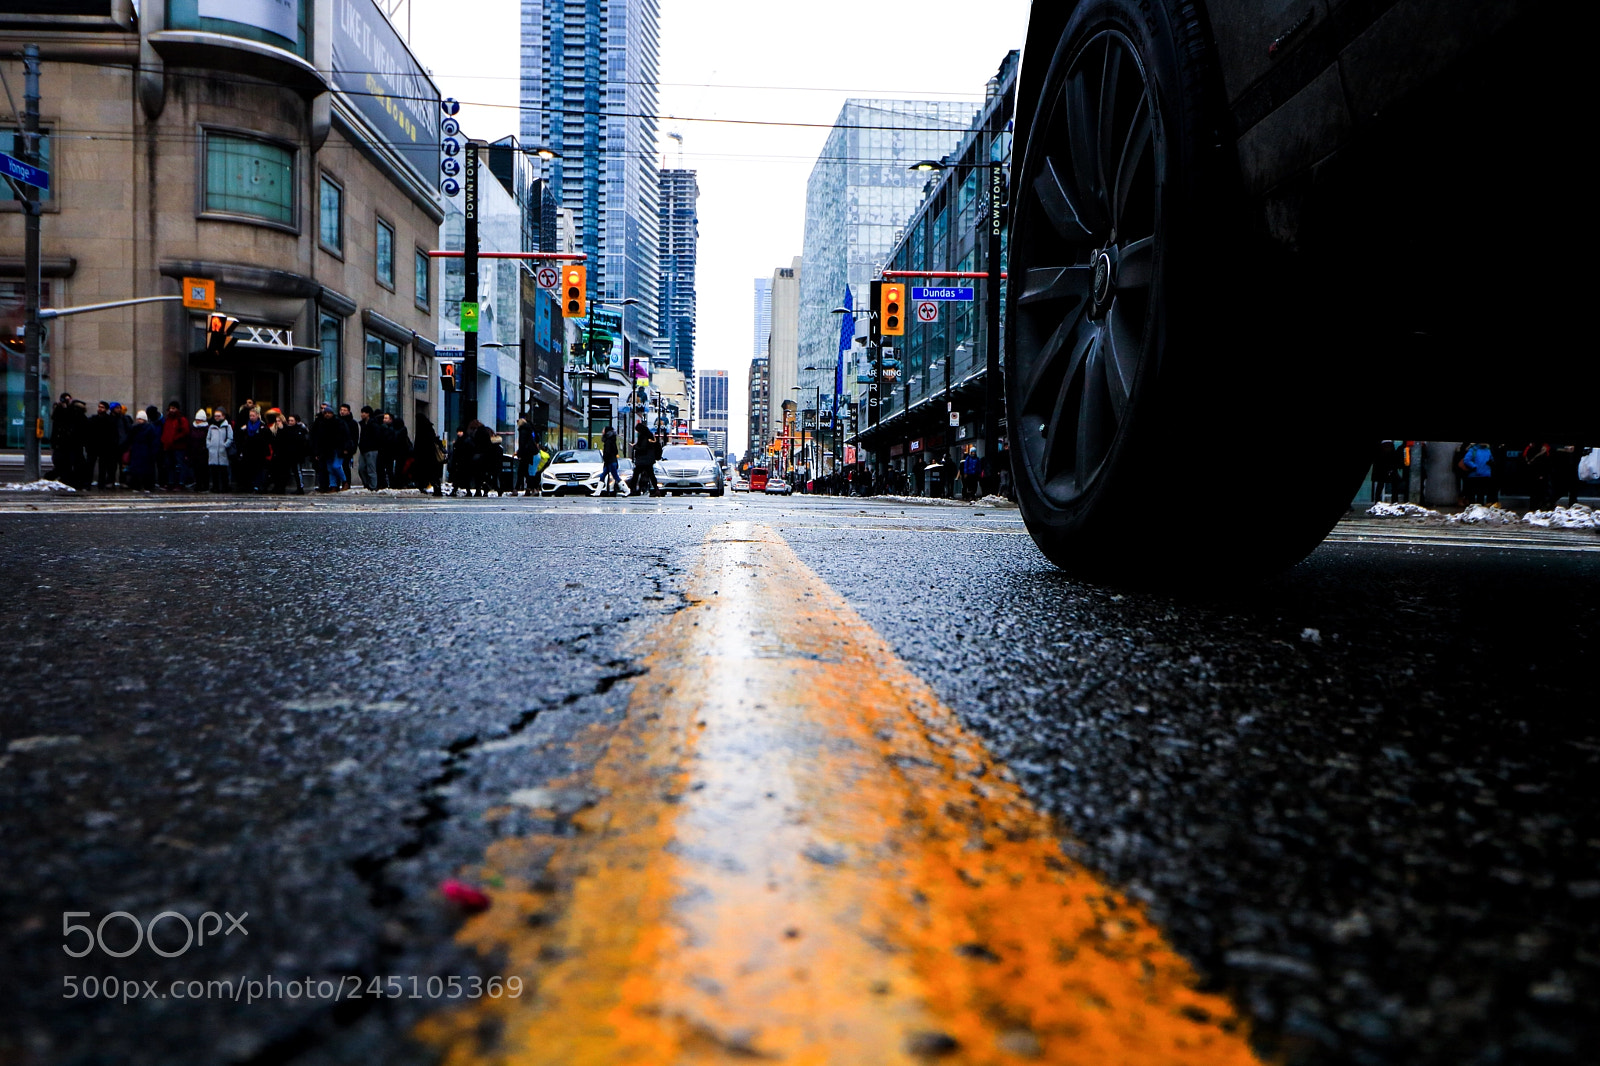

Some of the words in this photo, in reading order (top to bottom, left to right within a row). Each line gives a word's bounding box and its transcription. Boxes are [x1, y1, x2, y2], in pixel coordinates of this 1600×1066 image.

[8, 158, 30, 180] Yonge
[467, 148, 475, 219] DOWNTOWN
[922, 288, 956, 298] Dundas
[247, 327, 293, 348] XXI
[868, 311, 878, 407] WINRS
